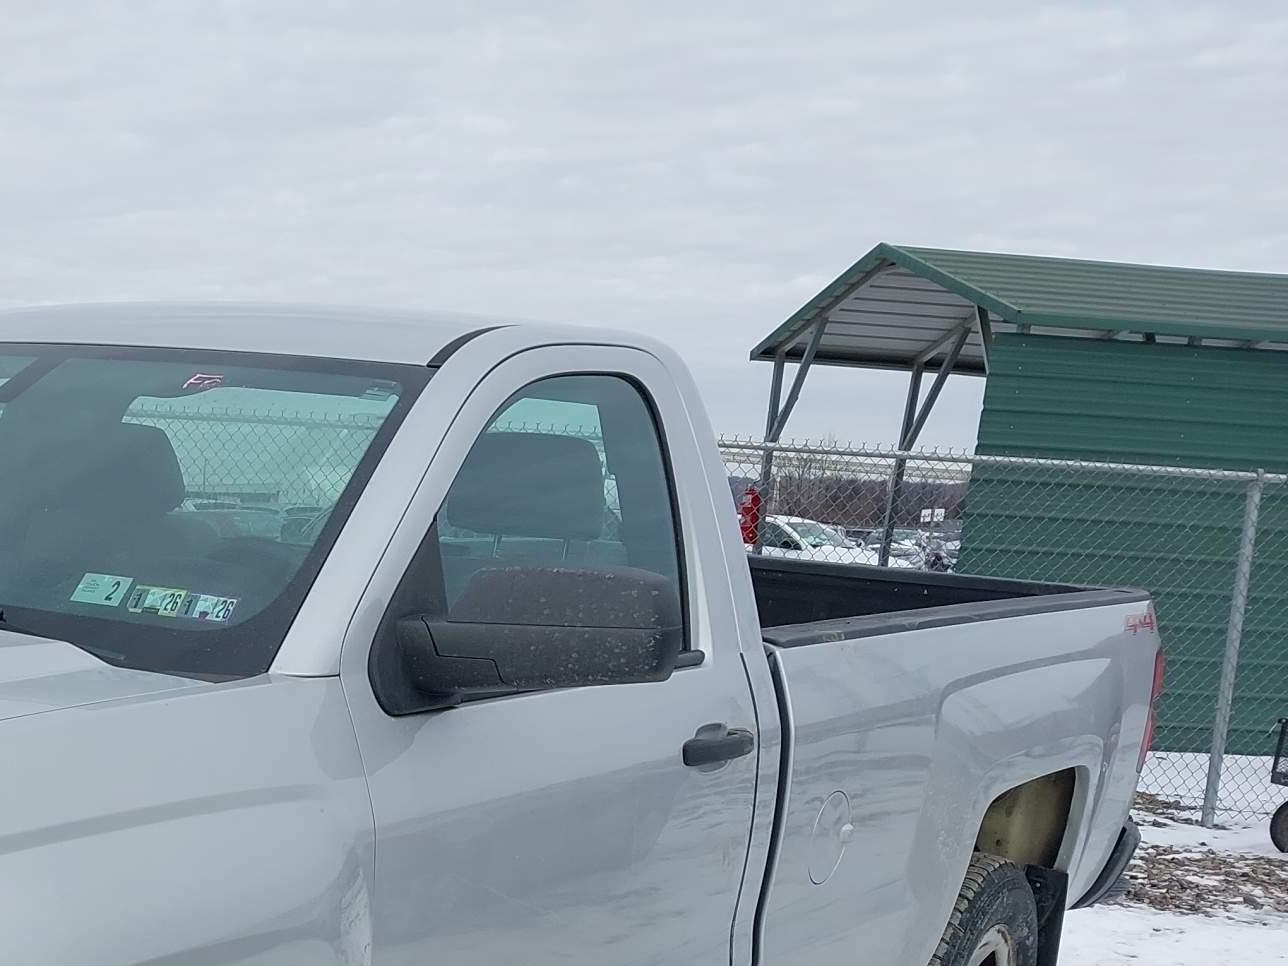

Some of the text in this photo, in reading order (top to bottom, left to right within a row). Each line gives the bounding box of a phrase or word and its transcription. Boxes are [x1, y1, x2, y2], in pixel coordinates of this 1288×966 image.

[104, 581, 120, 601] 2
[164, 593, 182, 612] 26
[216, 600, 233, 619] 26
